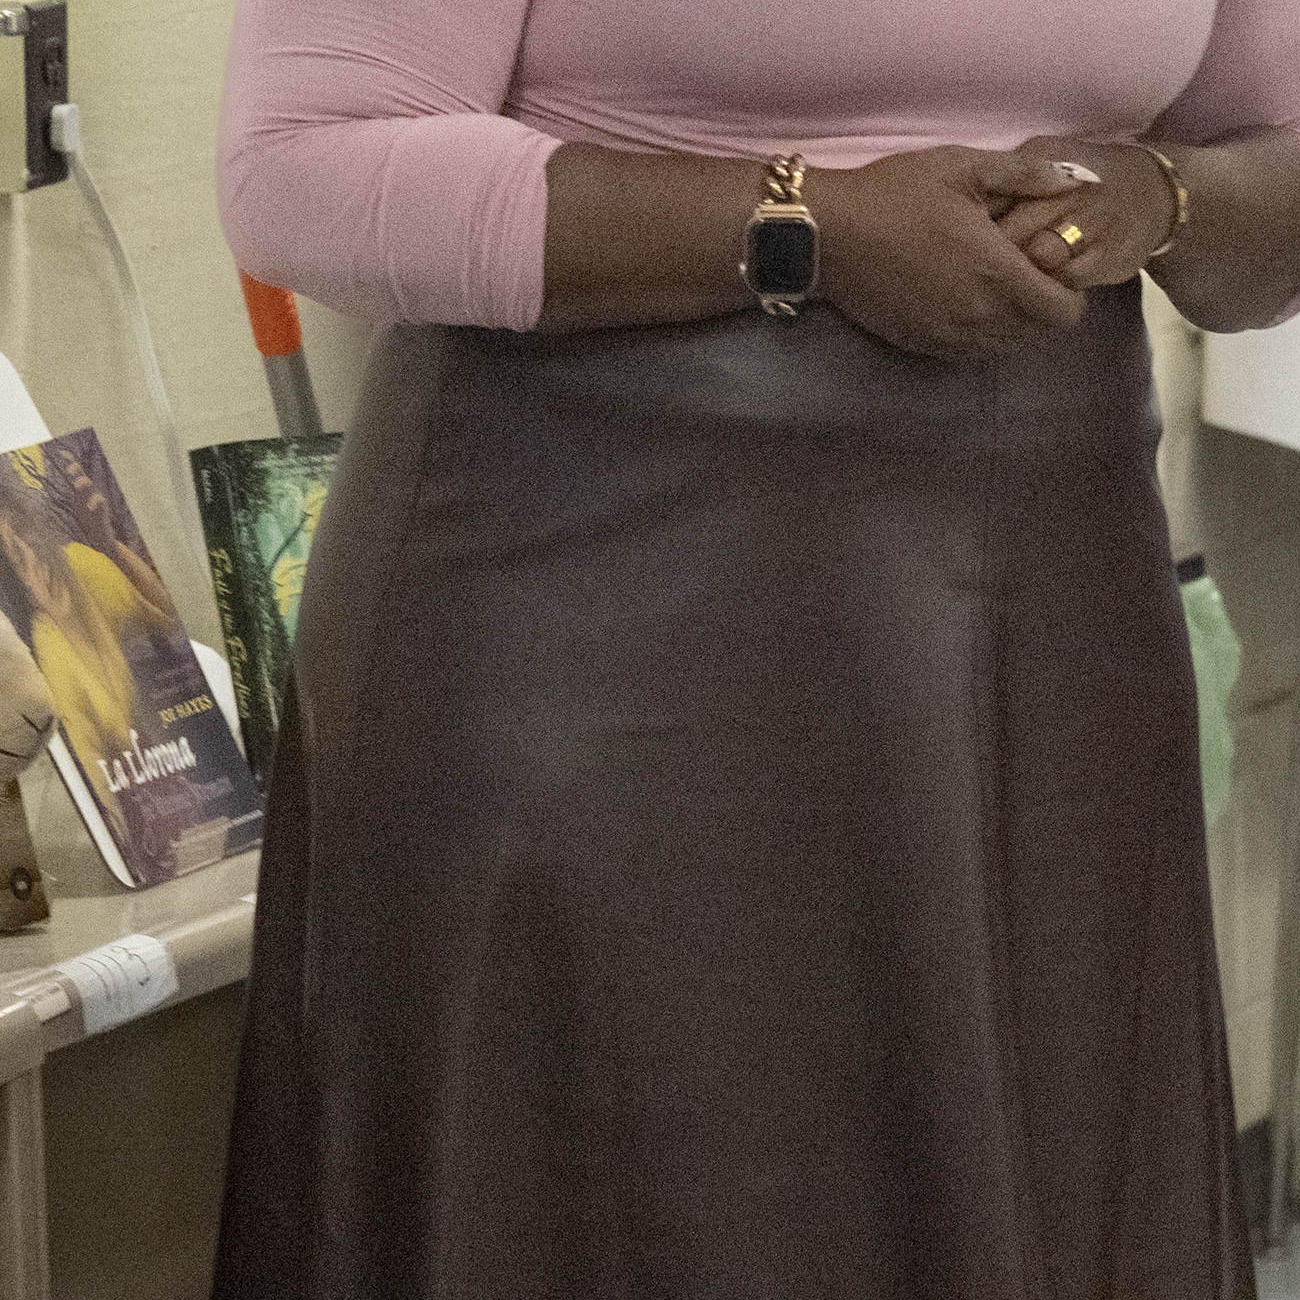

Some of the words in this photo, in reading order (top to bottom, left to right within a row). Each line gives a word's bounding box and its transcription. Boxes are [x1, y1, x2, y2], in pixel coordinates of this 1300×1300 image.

[210, 548, 234, 595] Fall
[226, 635, 252, 719] Fireflies
[177, 694, 214, 720] HAYES
[97, 757, 131, 794] La
[123, 728, 198, 785] Llorona
